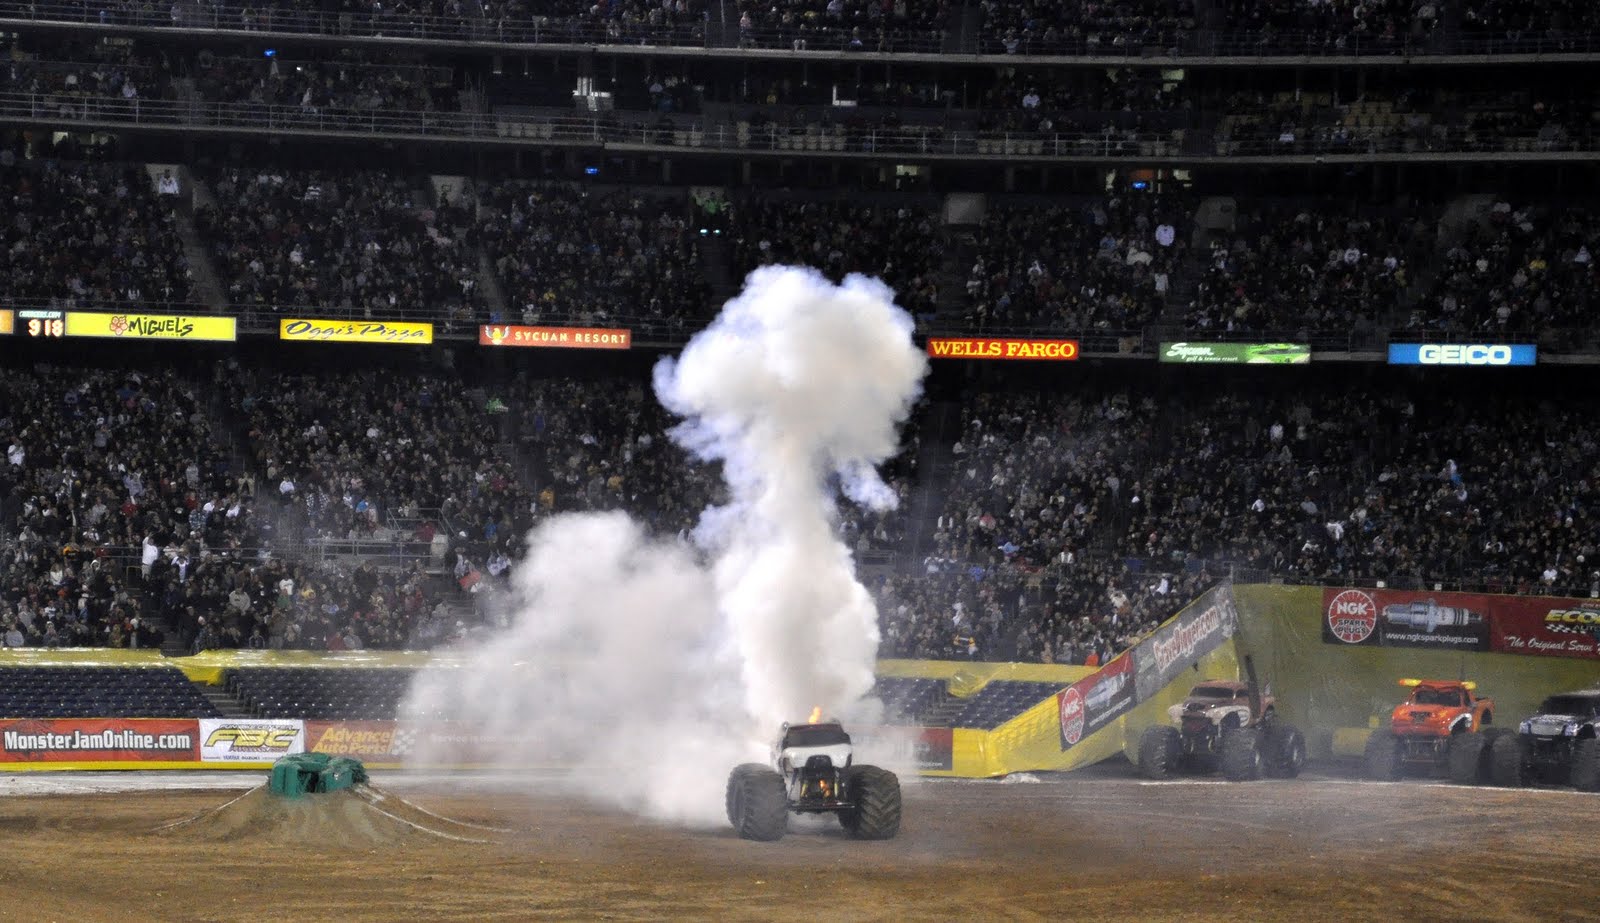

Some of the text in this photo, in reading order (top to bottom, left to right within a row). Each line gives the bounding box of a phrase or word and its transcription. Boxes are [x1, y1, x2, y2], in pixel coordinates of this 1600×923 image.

[285, 320, 425, 341] Oggi's Pizza
[514, 331, 626, 344] SYCUAN RESORT
[931, 341, 1075, 357] WELLS FARGO
[1418, 344, 1512, 365] GEICO
[1336, 602, 1368, 615] NGK
[1338, 618, 1367, 626] SPARK
[1337, 626, 1367, 635] PLUGS
[1385, 632, 1479, 644] www.ngksparkplugs.com
[1527, 637, 1566, 652] Original
[4, 730, 191, 750] MonsterJamOnline.com
[203, 728, 300, 748] FBC
[319, 727, 392, 743] Advance
[311, 740, 389, 755] Auto Parts
